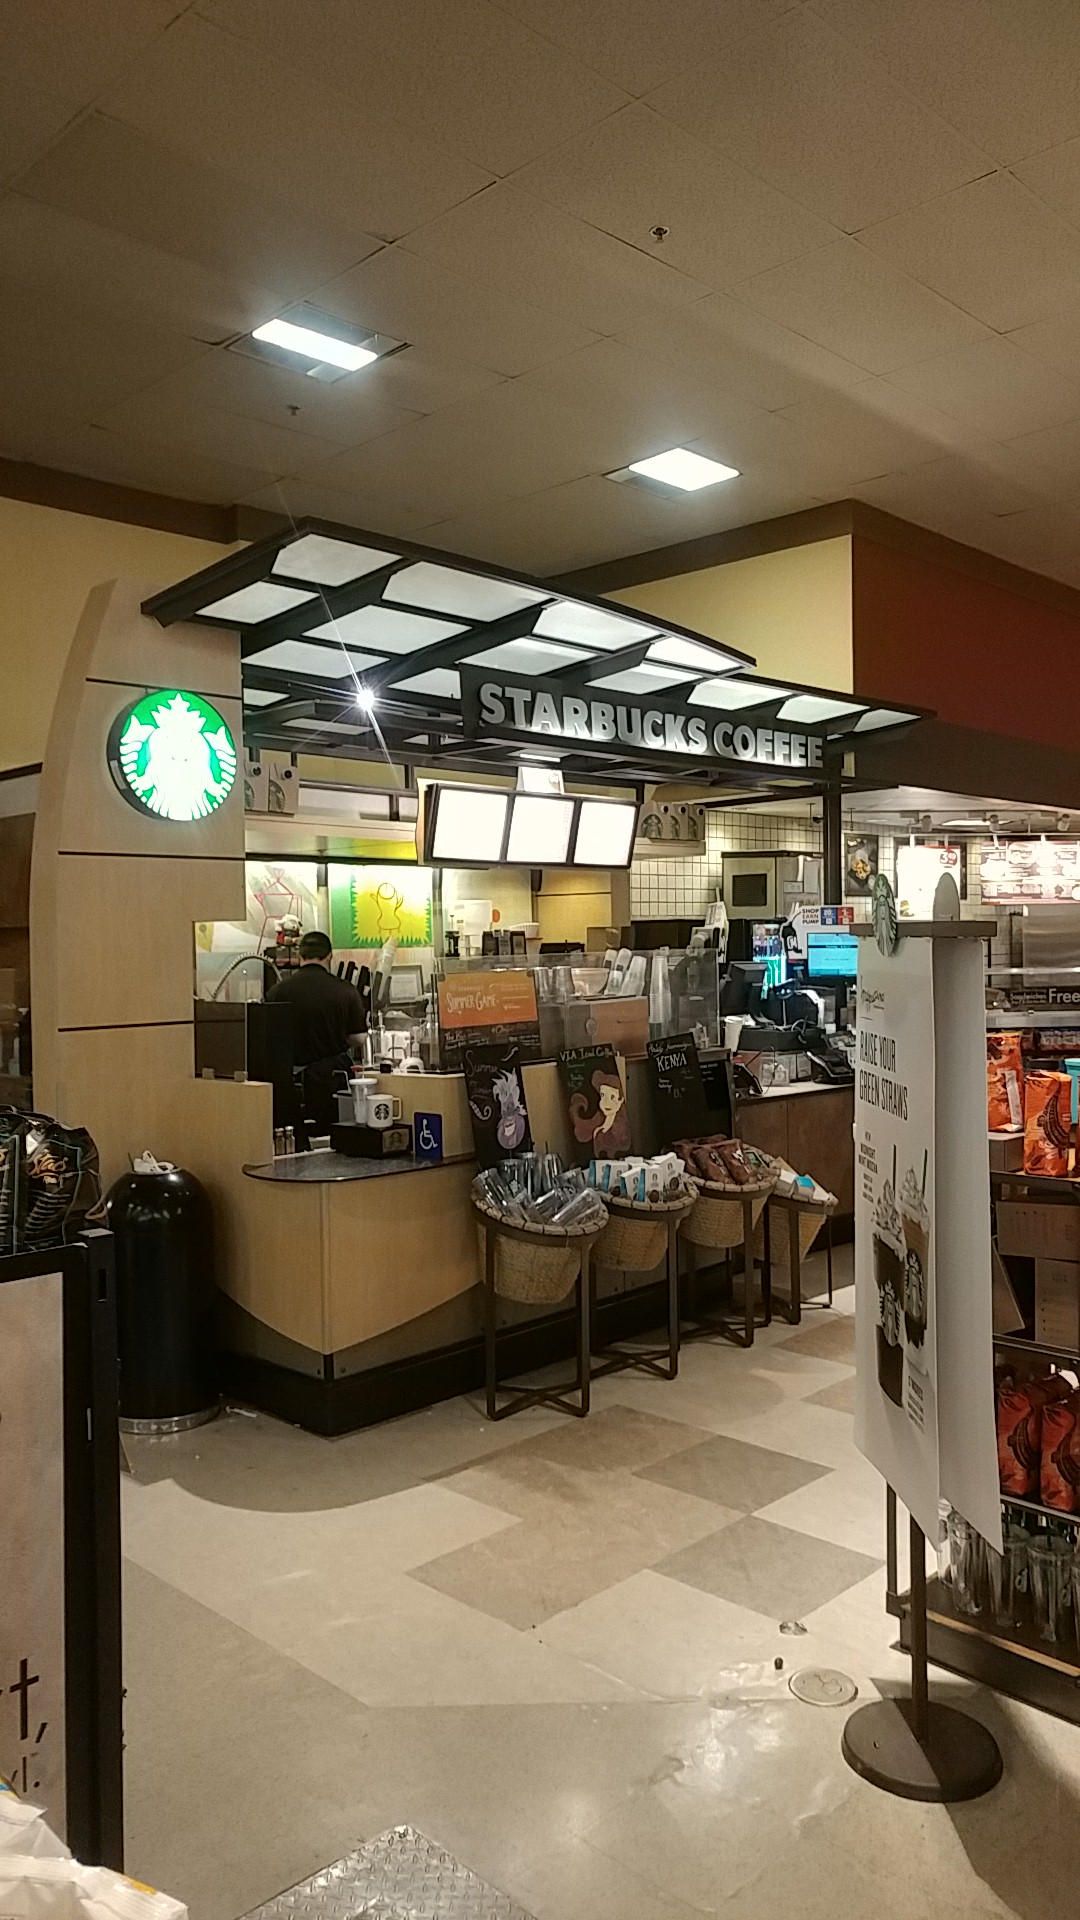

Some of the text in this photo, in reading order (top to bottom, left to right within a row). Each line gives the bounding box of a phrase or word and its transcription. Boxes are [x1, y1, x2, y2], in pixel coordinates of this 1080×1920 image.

[480, 683, 823, 767] STARBUCKS COFFEE
[446, 991, 498, 1013] SUMMER GAME
[560, 1049, 577, 1062] VIA
[656, 1052, 687, 1072] KENYA
[860, 1030, 896, 1074] RAISE YOUR
[860, 1069, 908, 1121] GREEN STRAWS
